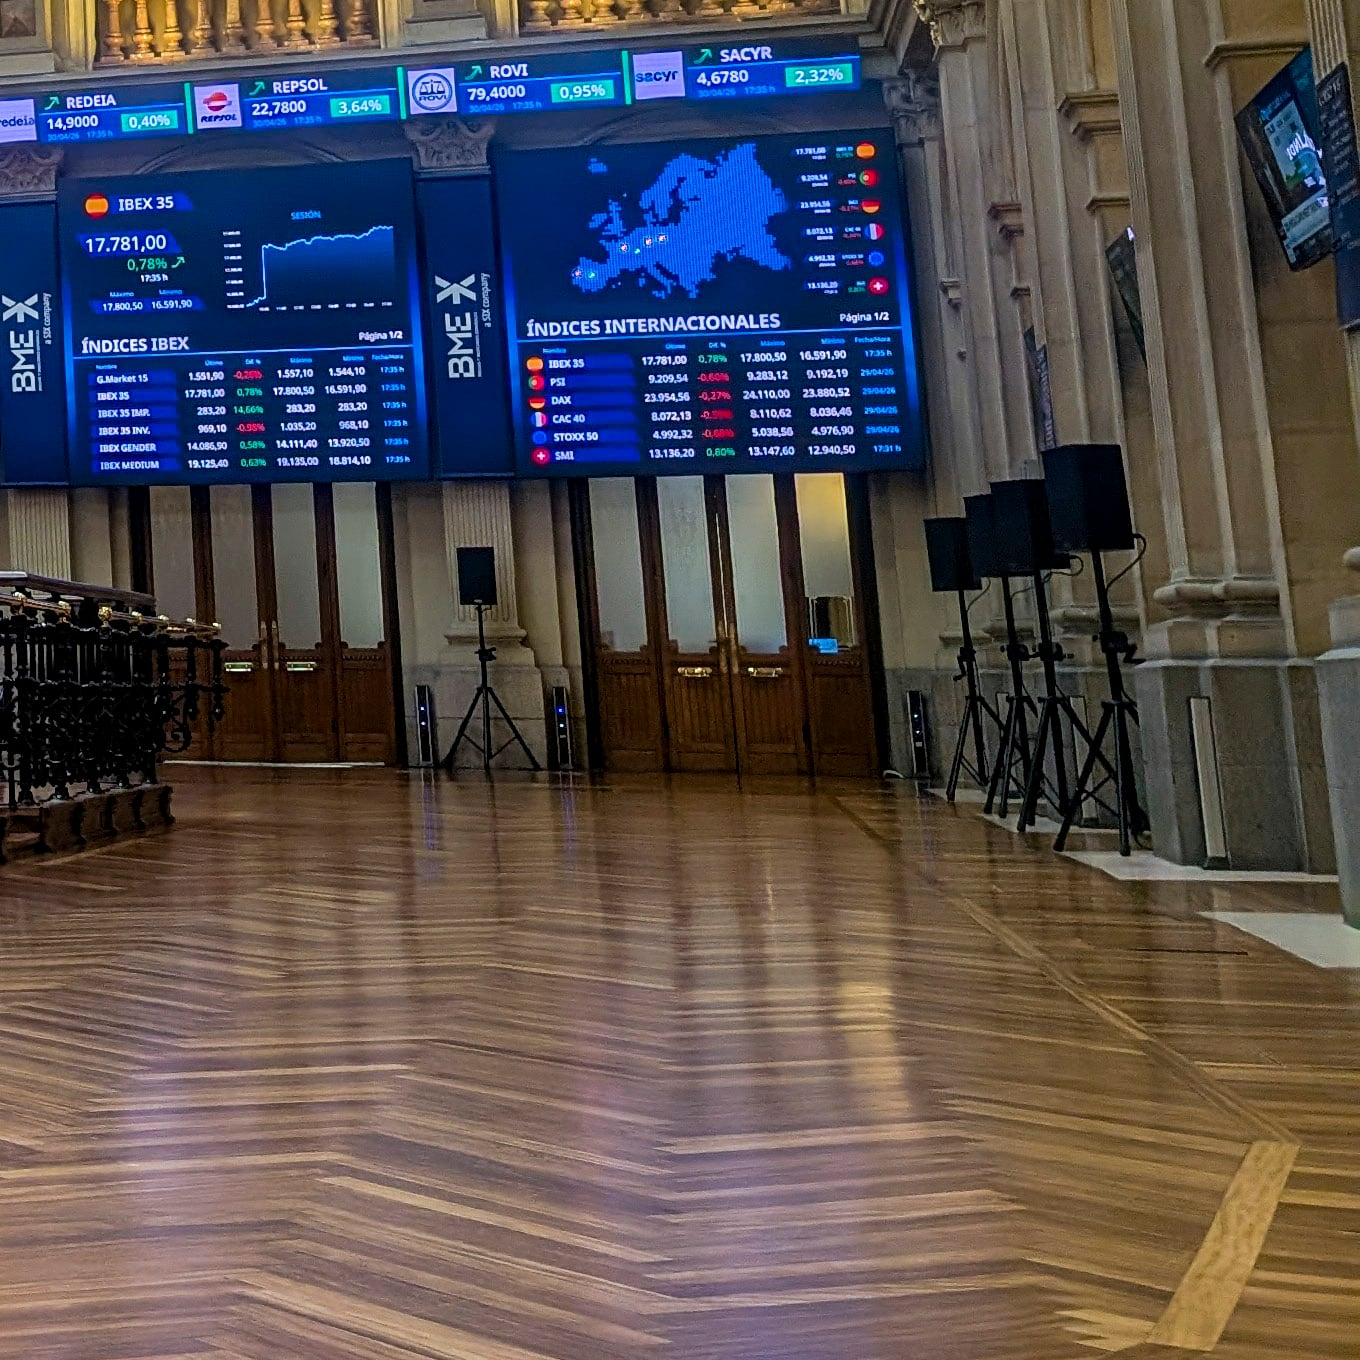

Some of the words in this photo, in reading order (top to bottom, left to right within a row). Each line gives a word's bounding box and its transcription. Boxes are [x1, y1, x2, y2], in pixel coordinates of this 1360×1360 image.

[720, 47, 772, 63] SACYR
[490, 64, 528, 79] ROVI
[635, 70, 679, 83] sacyr
[697, 69, 749, 86] 4,6780
[795, 67, 843, 83] 2,32%
[273, 79, 328, 94] REPSOL
[467, 85, 525, 101] 79,4000
[559, 83, 606, 99] 0,95%
[66, 94, 116, 109] REDEIA
[251, 100, 307, 116] 22,7800
[338, 100, 382, 114] 3,64%
[47, 115, 99, 130] 14,9000
[129, 115, 170, 129] 0,40%
[118, 198, 153, 212] IBEX
[156, 196, 174, 210] 35
[86, 235, 167, 254] 17.781,00
[127, 257, 167, 272] 0,78%
[526, 319, 600, 337] ÍNDICES
[604, 312, 781, 335] INTERNACIONALES
[840, 313, 872, 324] Página
[874, 312, 889, 321] 1/2
[389, 331, 403, 339] 1/2
[81, 337, 147, 354] ÍNDICES
[151, 336, 190, 351] IBEX
[445, 312, 475, 378] BME
[10, 330, 36, 392] BME
[642, 356, 687, 366] 17.781,00
[740, 352, 786, 363] 17.800,50
[800, 350, 846, 361] 16.591,90
[96, 376, 136, 384] G.Market
[139, 374, 148, 382] 15
[550, 378, 566, 387] PSI
[806, 369, 848, 379] 9.192,19
[551, 396, 572, 405] DAX
[552, 415, 572, 424] CAC
[574, 414, 585, 423] 40
[554, 433, 585, 442] STOXX
[586, 432, 598, 441] 50
[808, 445, 855, 455] 12.940,50
